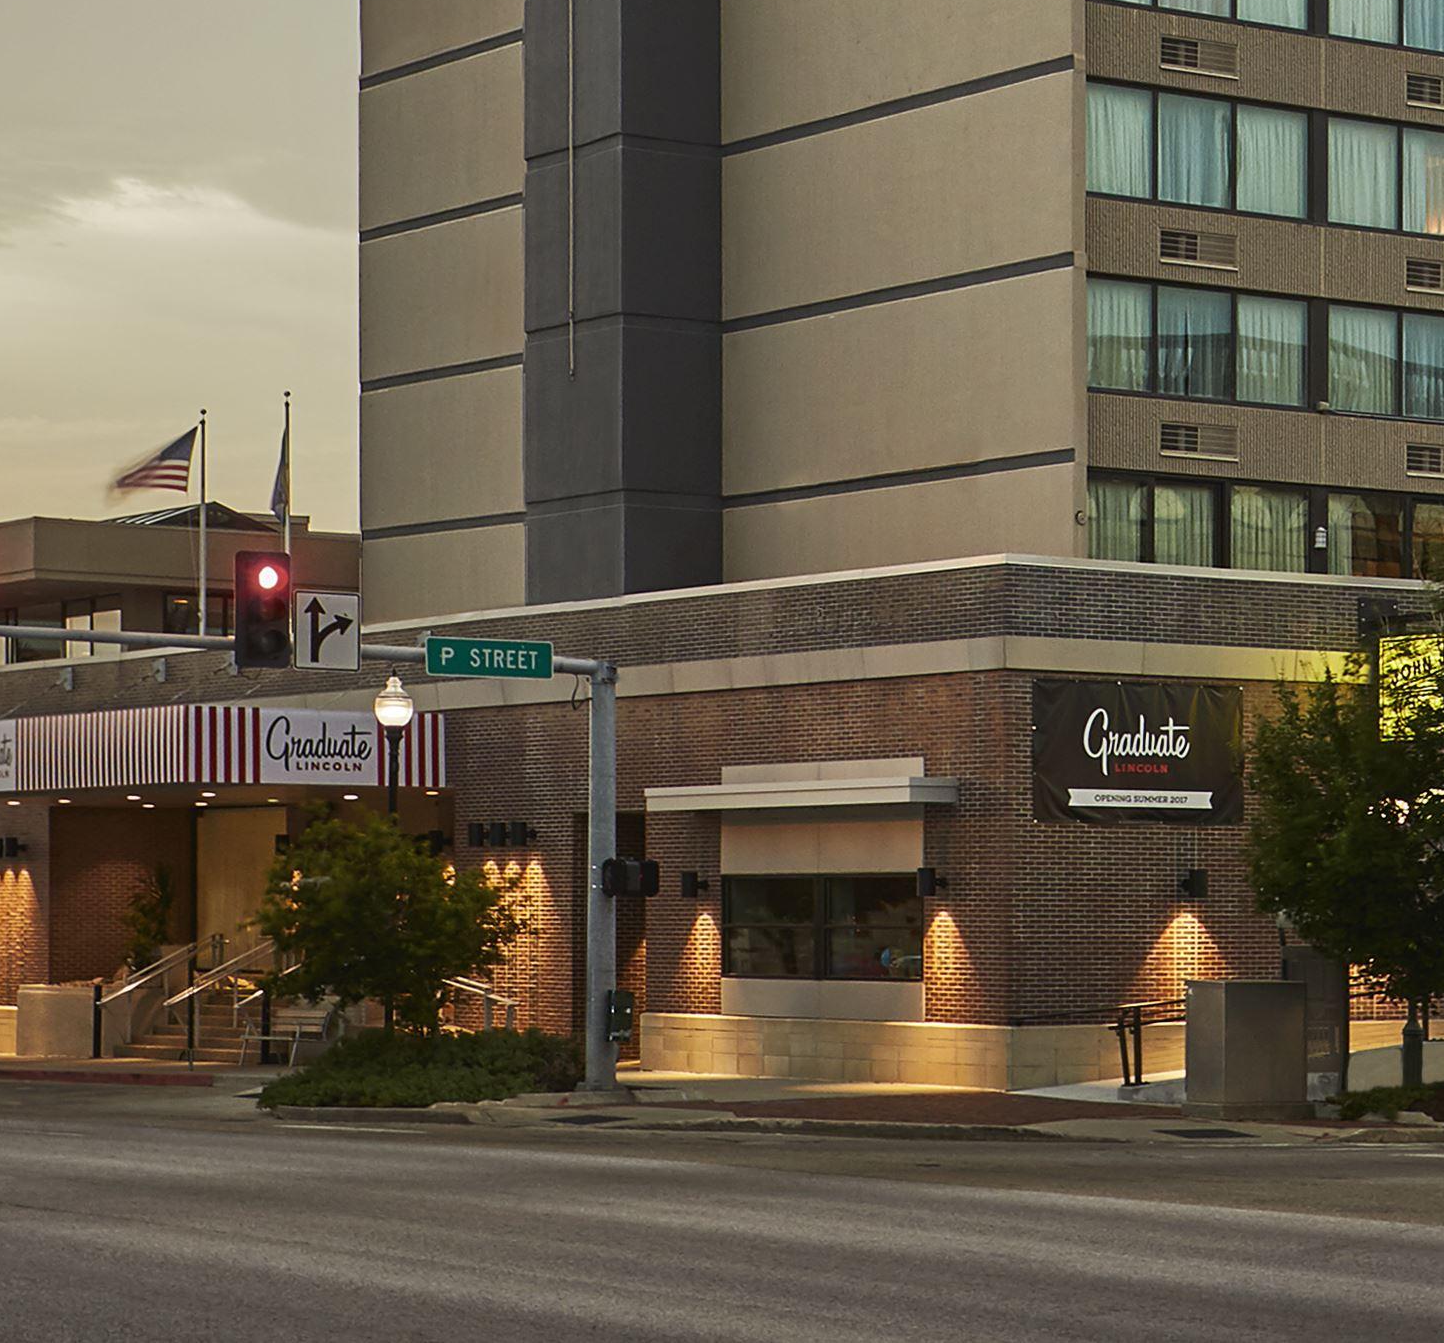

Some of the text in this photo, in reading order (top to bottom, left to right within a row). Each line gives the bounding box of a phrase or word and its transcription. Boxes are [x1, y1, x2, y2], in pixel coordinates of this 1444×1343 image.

[441, 647, 538, 670] P STREET
[265, 715, 373, 772] Graduate
[1083, 708, 1191, 776] Graduate
[296, 761, 362, 772] LINCOLN
[1115, 763, 1169, 774] LINCOLN
[1094, 794, 1188, 804] OPENING SUMMER 2017
